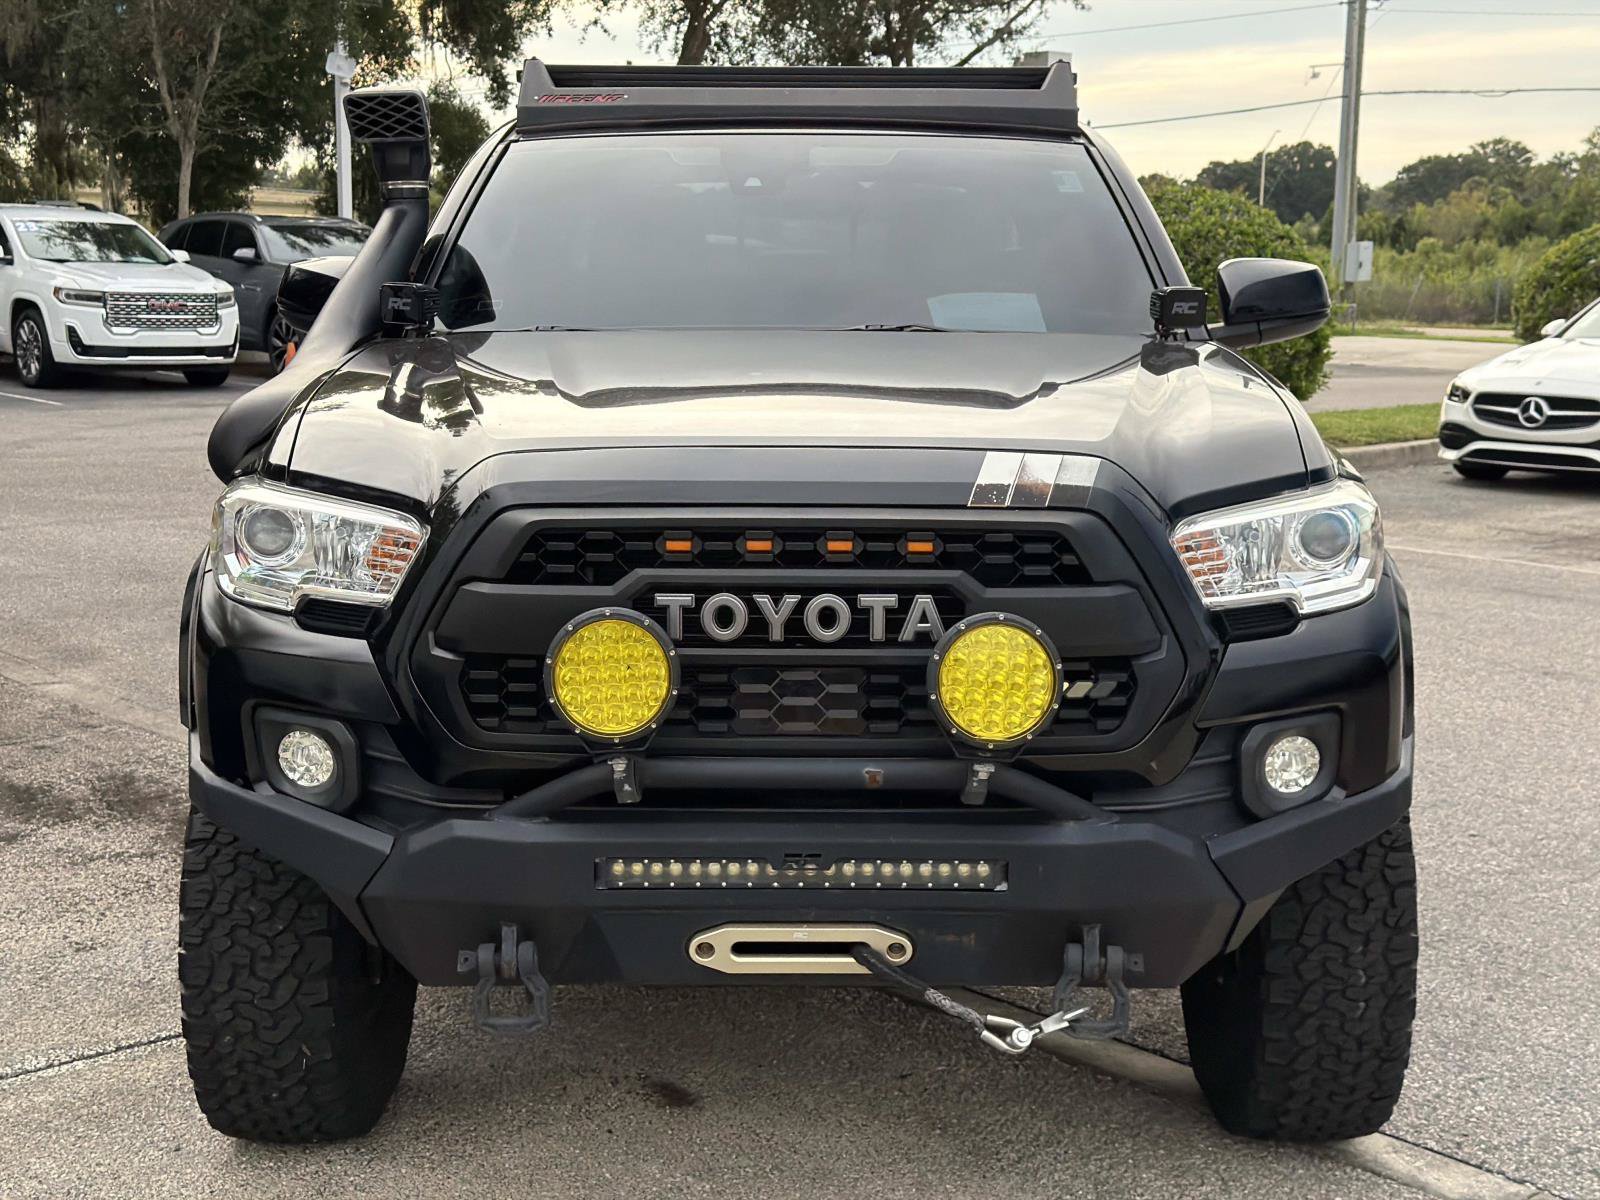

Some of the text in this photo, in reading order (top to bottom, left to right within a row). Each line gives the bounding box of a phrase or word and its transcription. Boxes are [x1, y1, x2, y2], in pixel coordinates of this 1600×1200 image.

[148, 299, 188, 311] GMC
[388, 297, 412, 310] RC
[1171, 302, 1200, 314] RC
[654, 592, 946, 642] TOYOTA
